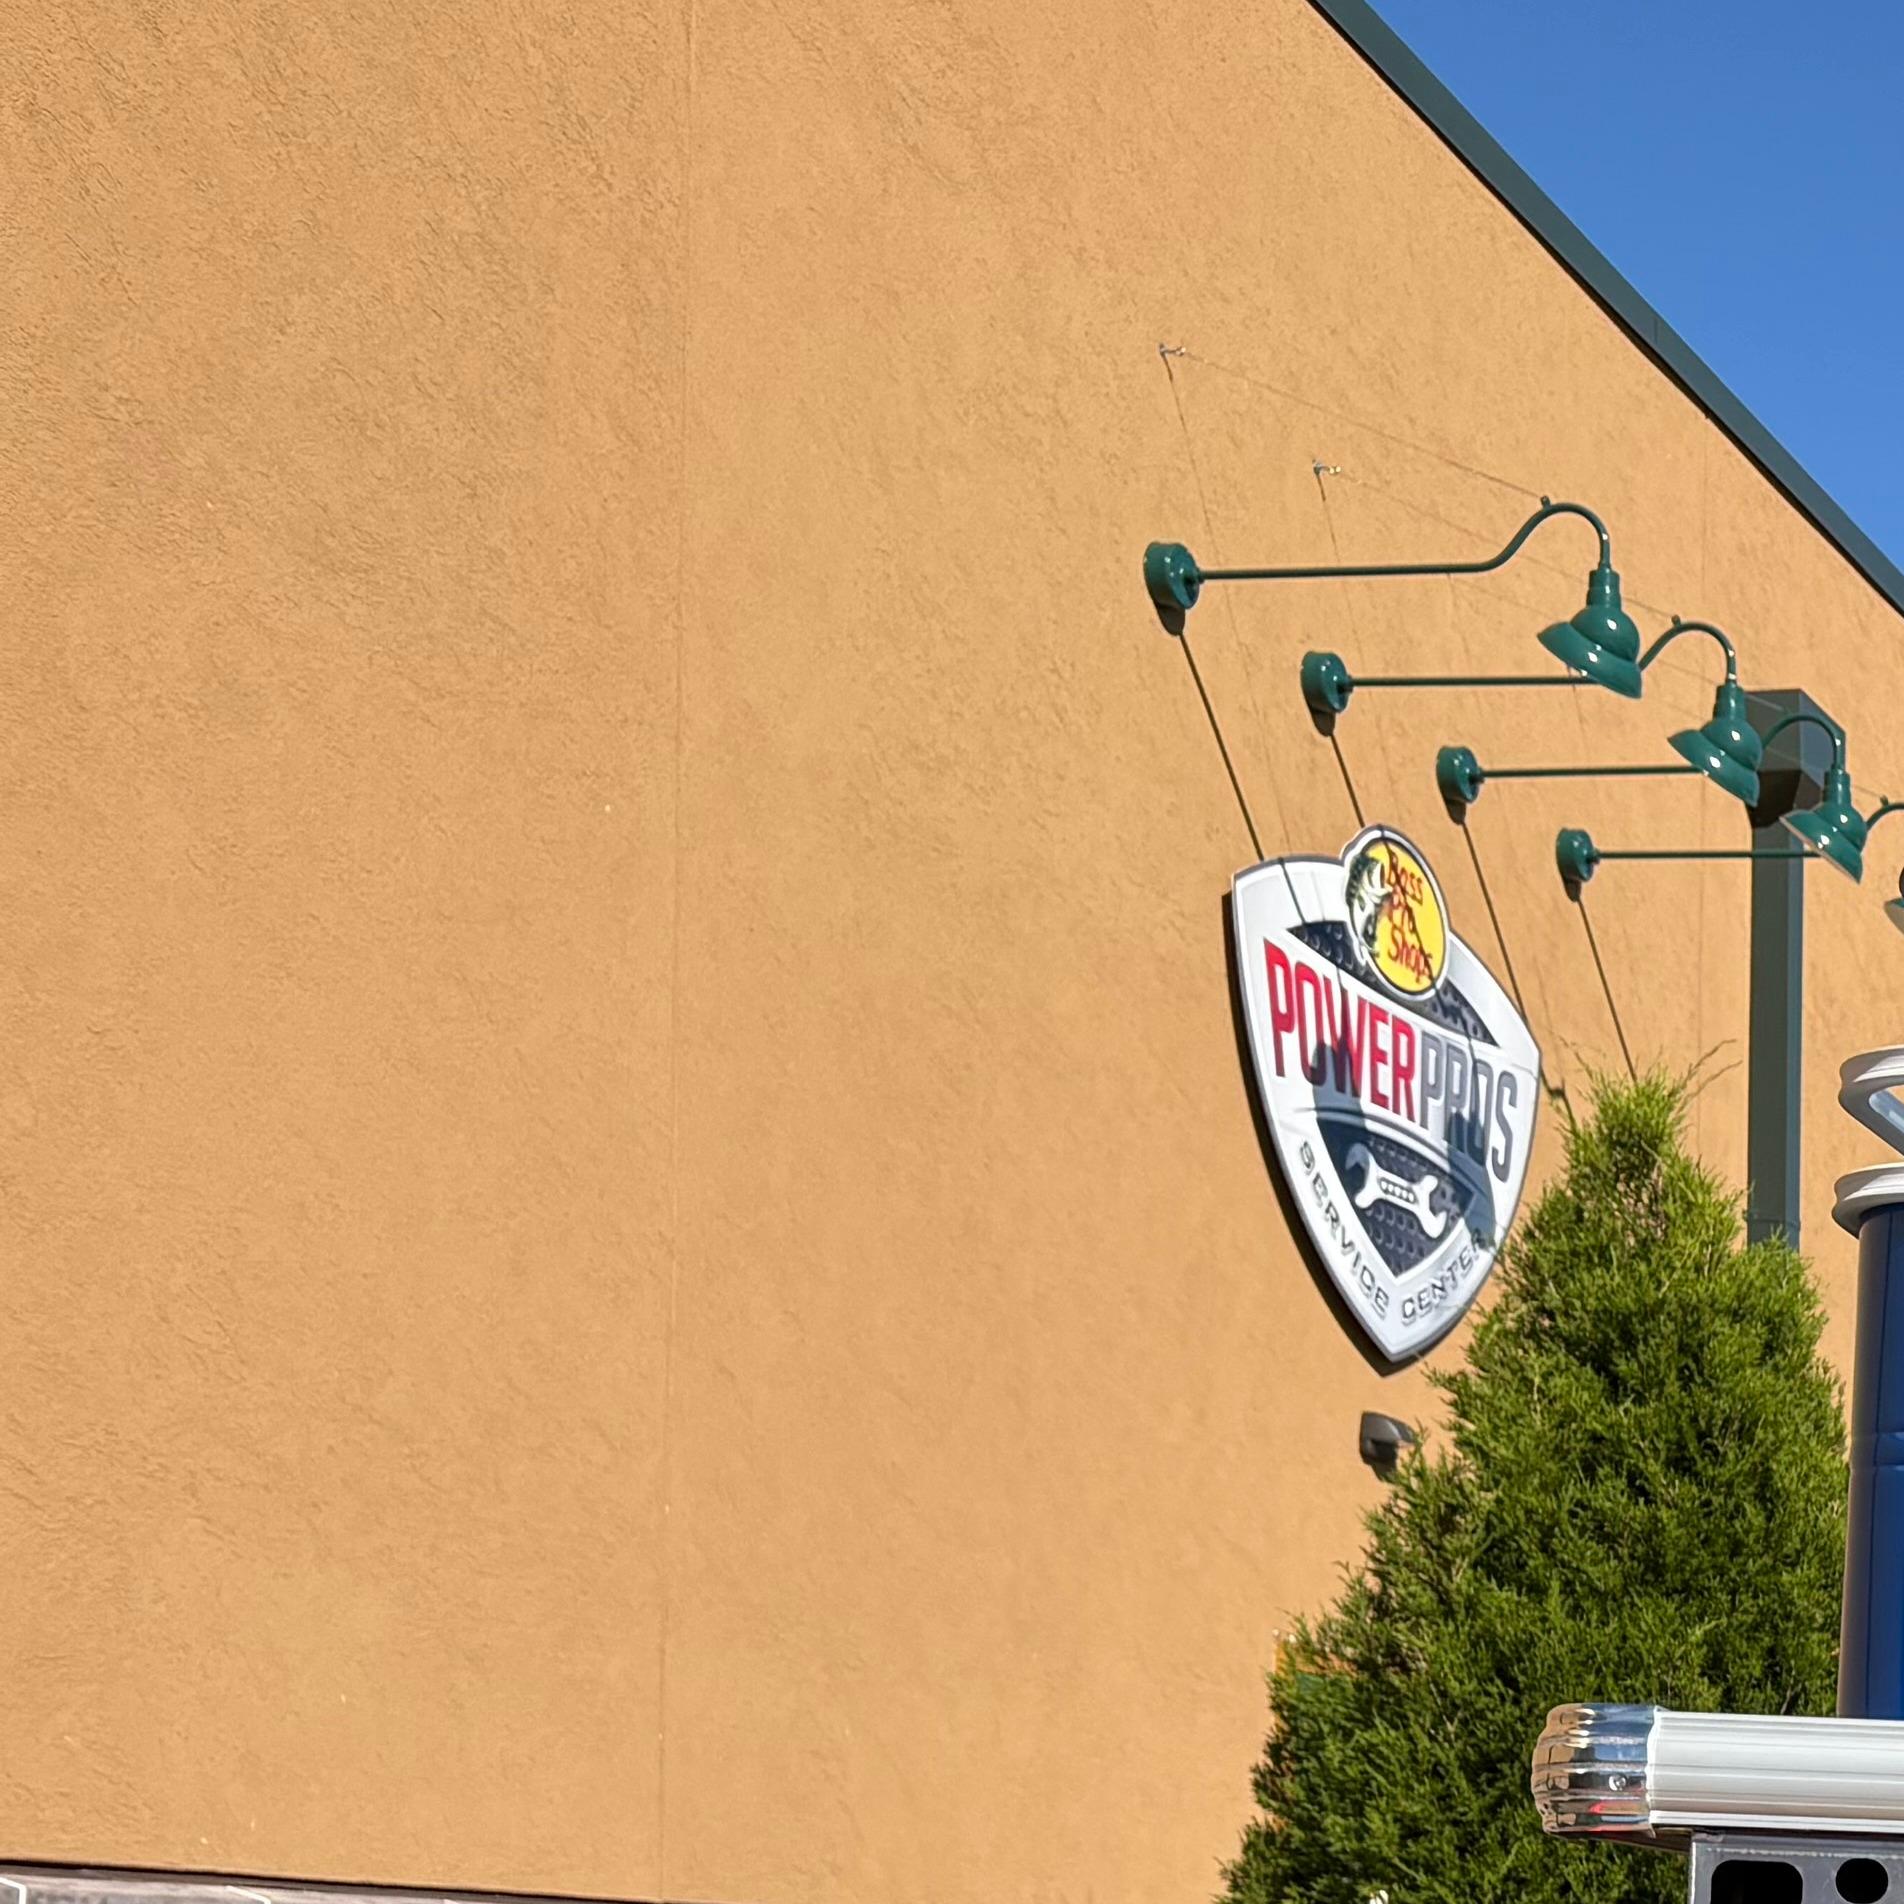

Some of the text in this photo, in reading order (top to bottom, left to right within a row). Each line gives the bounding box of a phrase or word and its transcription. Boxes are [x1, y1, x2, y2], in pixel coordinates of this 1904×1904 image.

[1387, 851, 1423, 905] Bass
[1388, 925, 1433, 983] Shops
[1300, 1141, 1483, 1319] SERVICE CENTER
